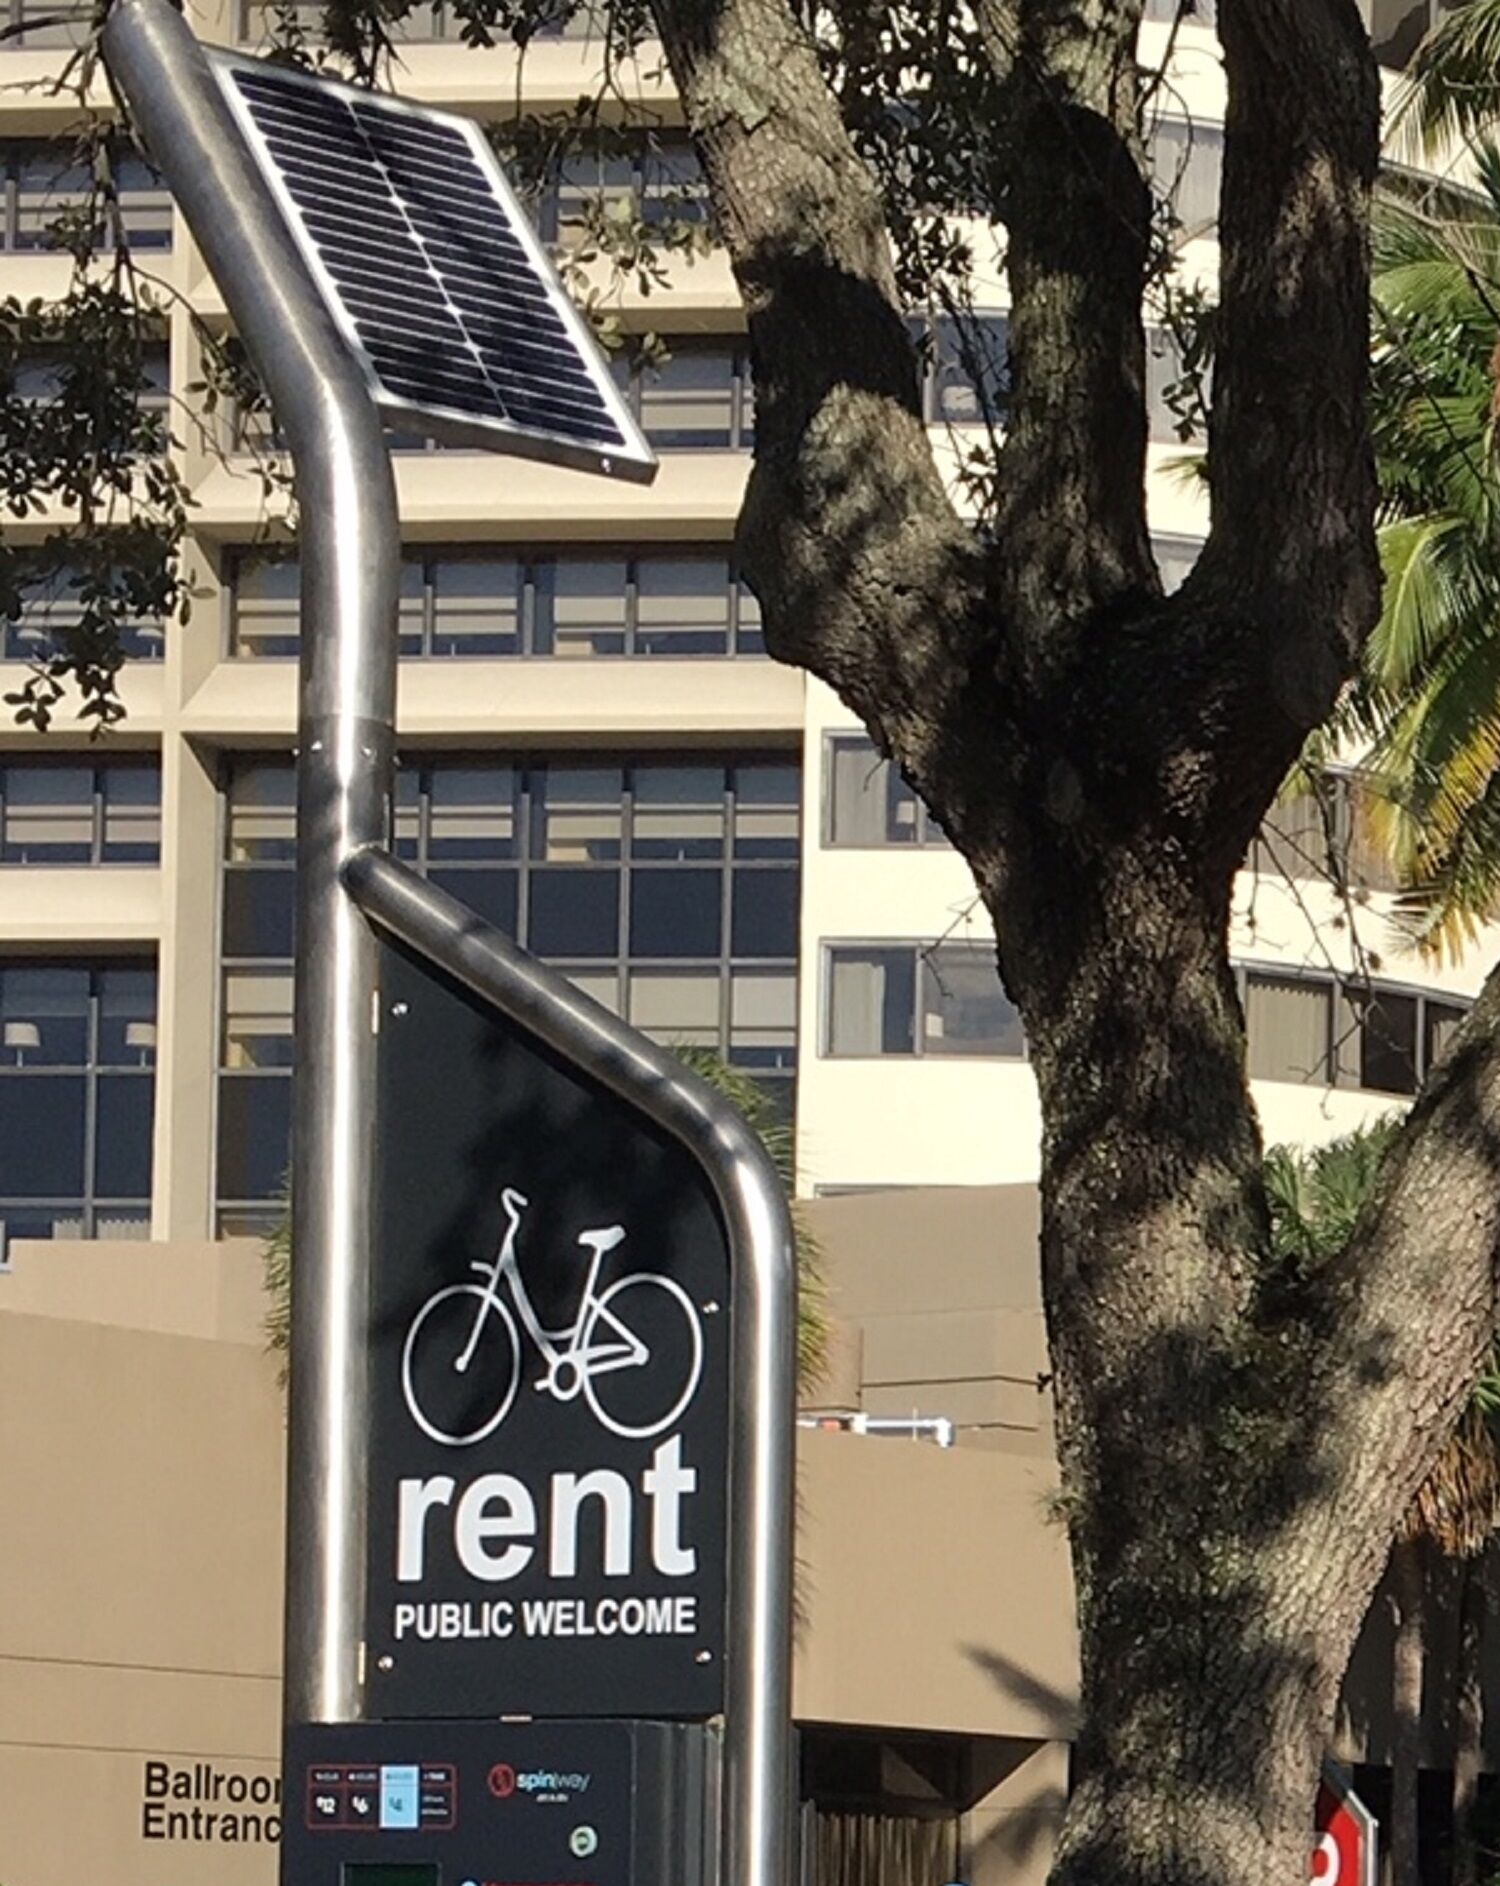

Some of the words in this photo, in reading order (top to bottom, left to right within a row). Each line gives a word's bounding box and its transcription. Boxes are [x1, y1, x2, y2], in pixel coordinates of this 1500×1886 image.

[396, 1432, 697, 1583] rent
[394, 1601, 514, 1640] PUBLIC
[522, 1596, 697, 1637] WELCOME
[145, 1761, 282, 1804] Ballroo
[517, 1768, 591, 1793] spinway
[143, 1802, 282, 1843] Entranc
